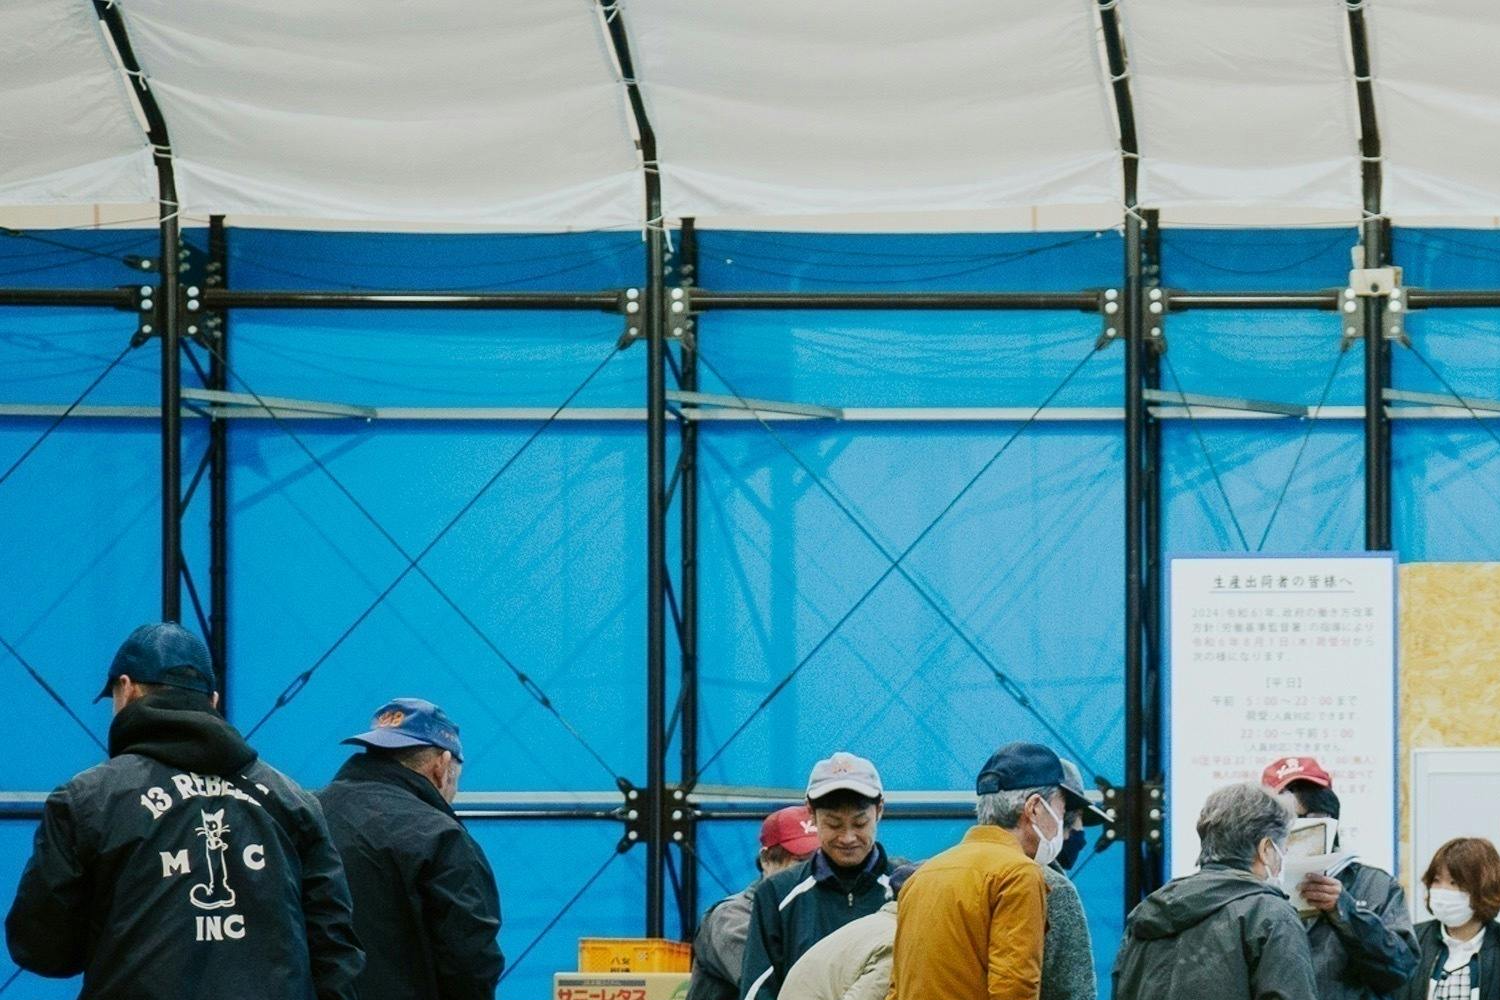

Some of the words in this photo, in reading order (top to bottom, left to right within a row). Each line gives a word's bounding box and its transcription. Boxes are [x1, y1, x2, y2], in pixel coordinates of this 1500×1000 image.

[141, 787, 173, 820] 13
[171, 772, 269, 806] REBE
[159, 849, 191, 877] M
[243, 843, 266, 871] C
[195, 914, 246, 941] INC
